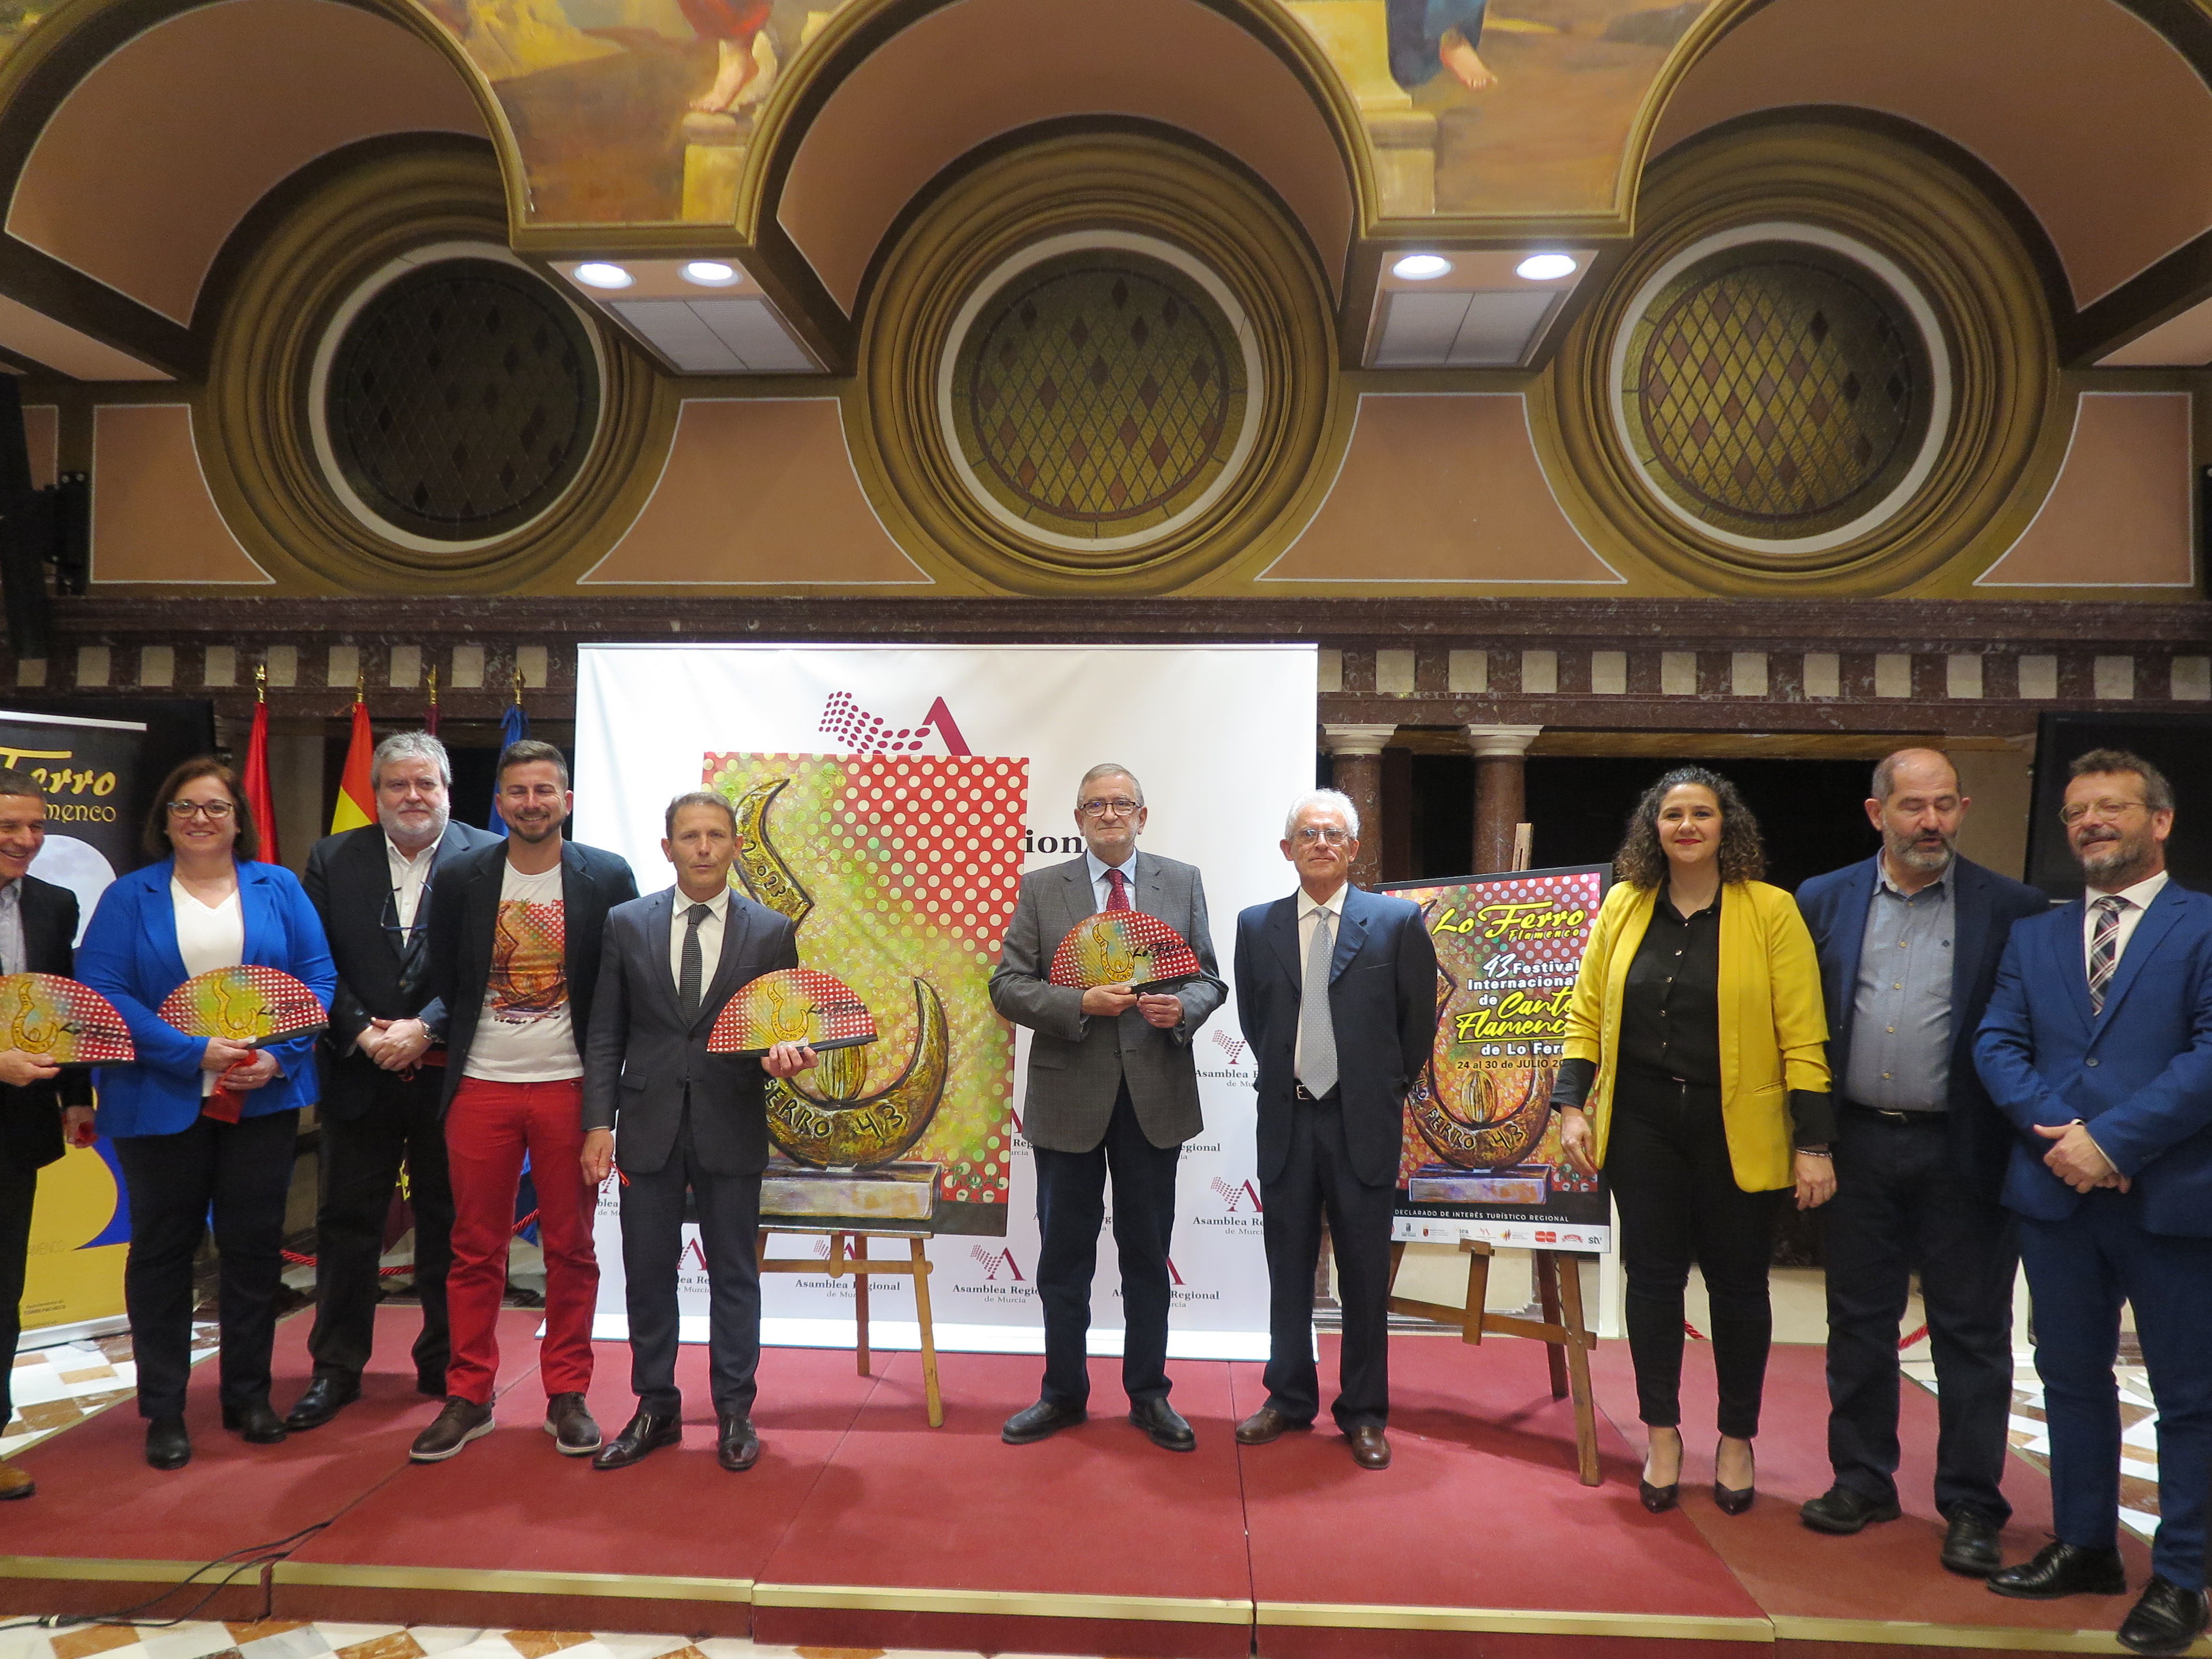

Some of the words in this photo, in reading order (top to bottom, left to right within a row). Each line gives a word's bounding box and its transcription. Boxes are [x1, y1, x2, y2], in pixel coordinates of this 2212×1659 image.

[44, 803, 116, 823] menco
[1431, 908, 1475, 936] Lo
[1477, 901, 1585, 939] Ferro
[1508, 928, 1580, 942] Flamenco
[1482, 953, 1517, 978] 43
[1513, 959, 1580, 975] Festival
[1479, 993, 1498, 1006] de
[1455, 1008, 1567, 1041] Flamenc
[1481, 1043, 1501, 1056] de
[1507, 1043, 1527, 1055] Lo
[1533, 1042, 1564, 1055] Ferr
[1457, 1061, 1470, 1069] 24
[1516, 1060, 1548, 1068] JULIO
[1195, 1069, 1249, 1078] Asamblea
[1181, 1143, 1221, 1153] egional
[1193, 1216, 1247, 1226] Asamblea
[1487, 1212, 1527, 1220] TURÍSTICO
[795, 1279, 849, 1289] Asamblea
[853, 1281, 900, 1292] gional
[952, 1285, 1006, 1294] Asamblea
[1010, 1286, 1040, 1296] Regio
[1171, 1291, 1220, 1301] Regional
